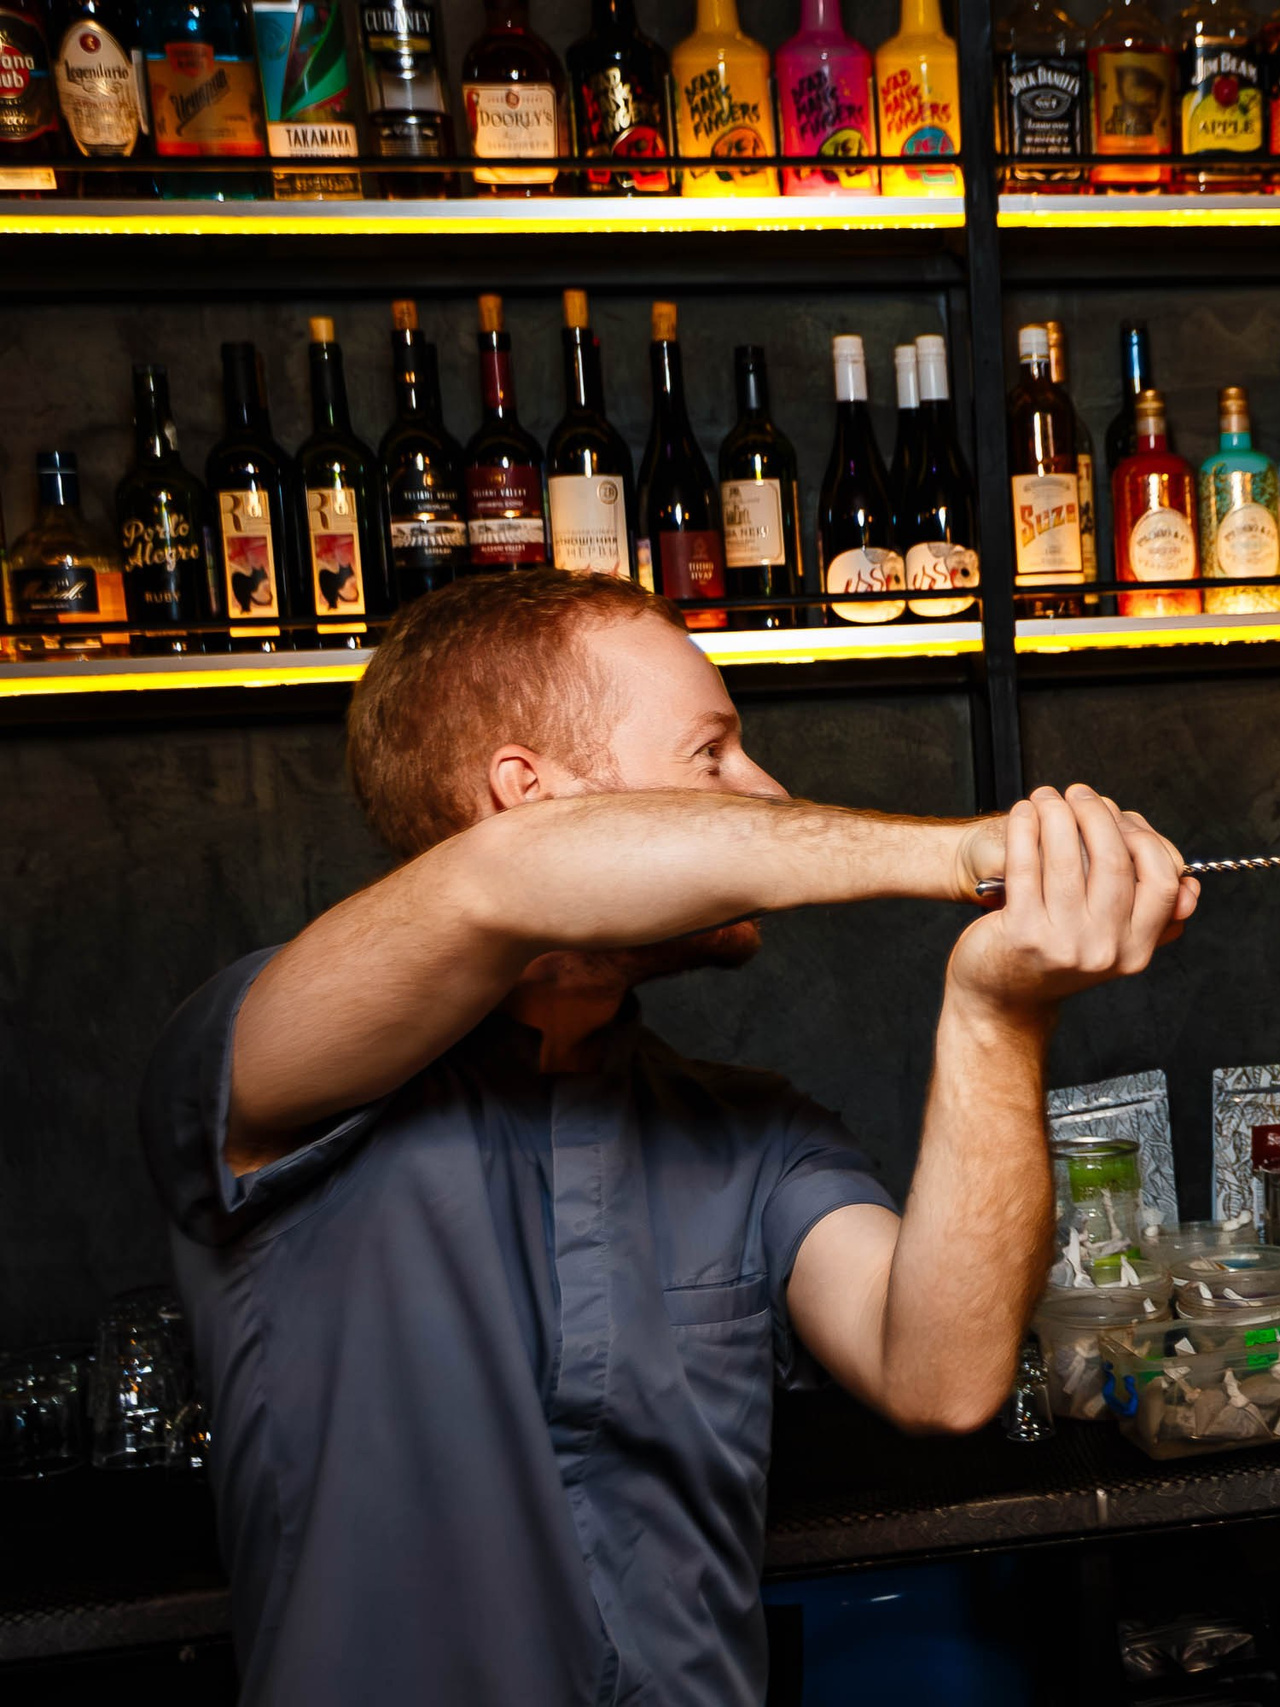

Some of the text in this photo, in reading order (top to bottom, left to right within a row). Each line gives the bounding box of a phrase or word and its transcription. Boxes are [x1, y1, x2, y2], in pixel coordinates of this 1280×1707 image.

[364, 8, 431, 33] CUBANEY
[65, 60, 129, 83] Legendario
[1191, 51, 1258, 86] JIM BEAM
[479, 109, 554, 131] DOORLY'S
[1199, 120, 1255, 135] APPLE
[286, 129, 351, 148] TAKAMAKA
